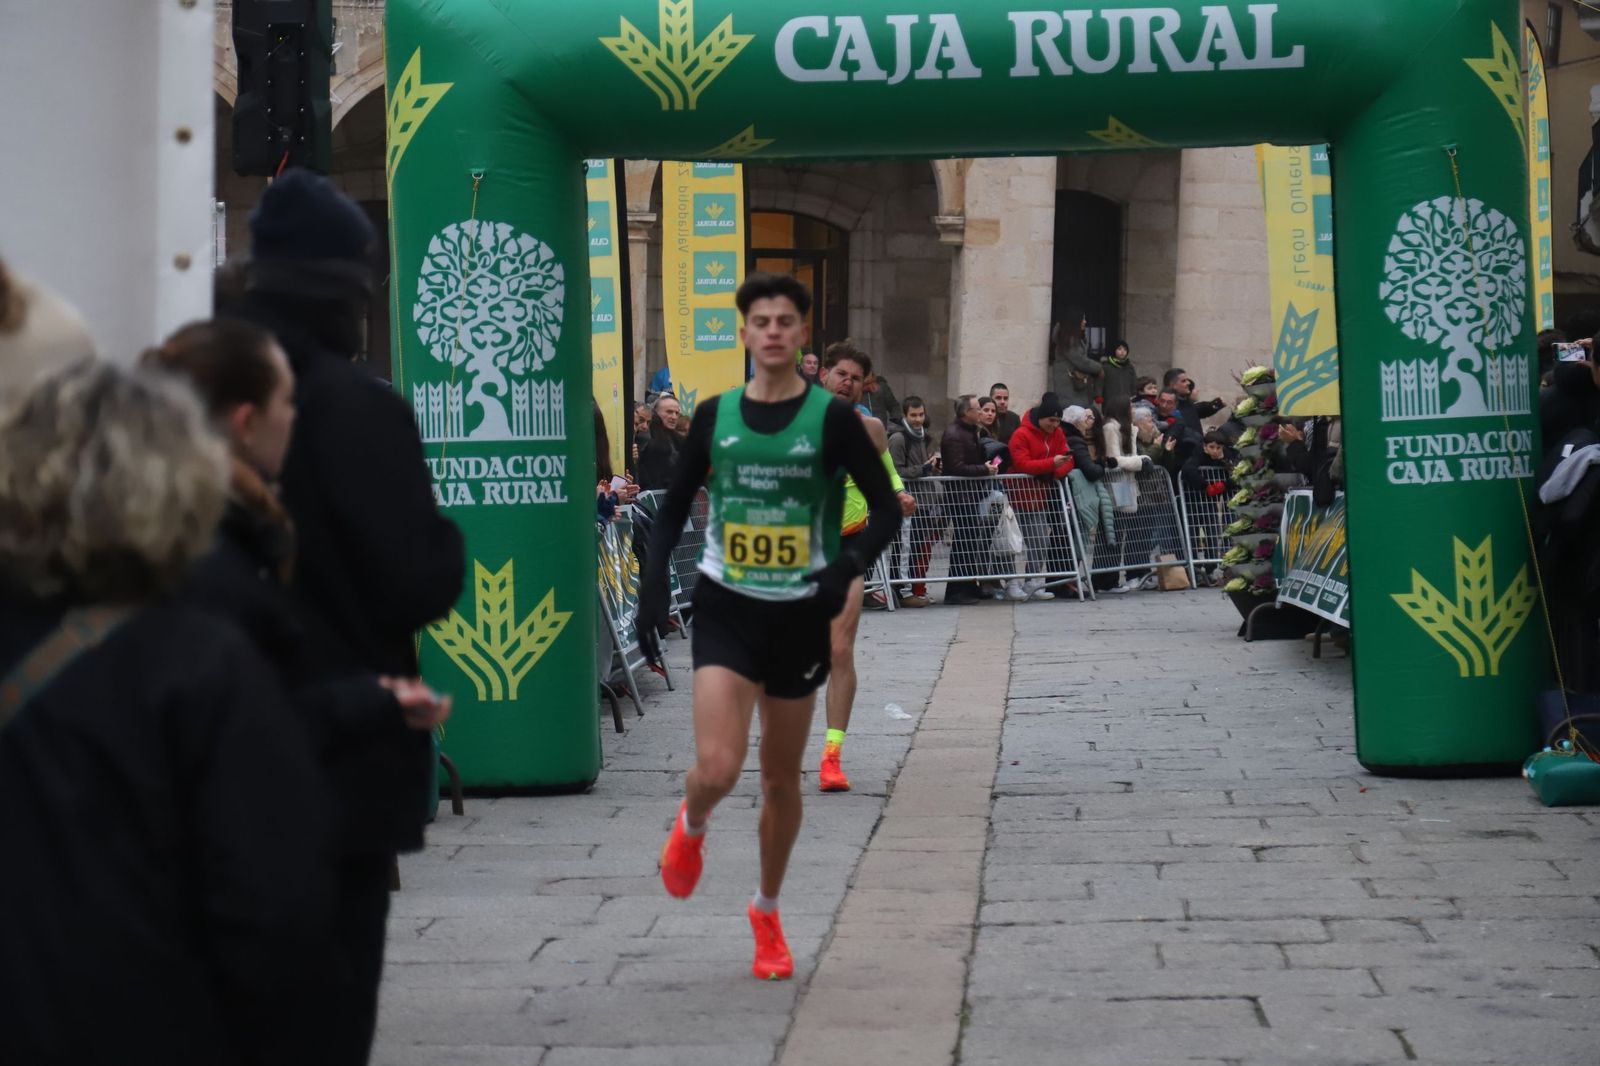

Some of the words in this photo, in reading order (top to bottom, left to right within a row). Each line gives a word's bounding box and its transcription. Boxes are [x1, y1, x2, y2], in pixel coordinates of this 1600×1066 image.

[774, 13, 982, 85] CAJA
[1007, 3, 1305, 77] RURAL
[1385, 430, 1533, 459] FUNDACION
[737, 463, 812, 478] universidad
[1387, 459, 1454, 485] CAJA
[1460, 455, 1534, 481] RURAL
[431, 482, 476, 507] AJA
[482, 480, 568, 505] RURAL
[729, 532, 797, 565] 695
